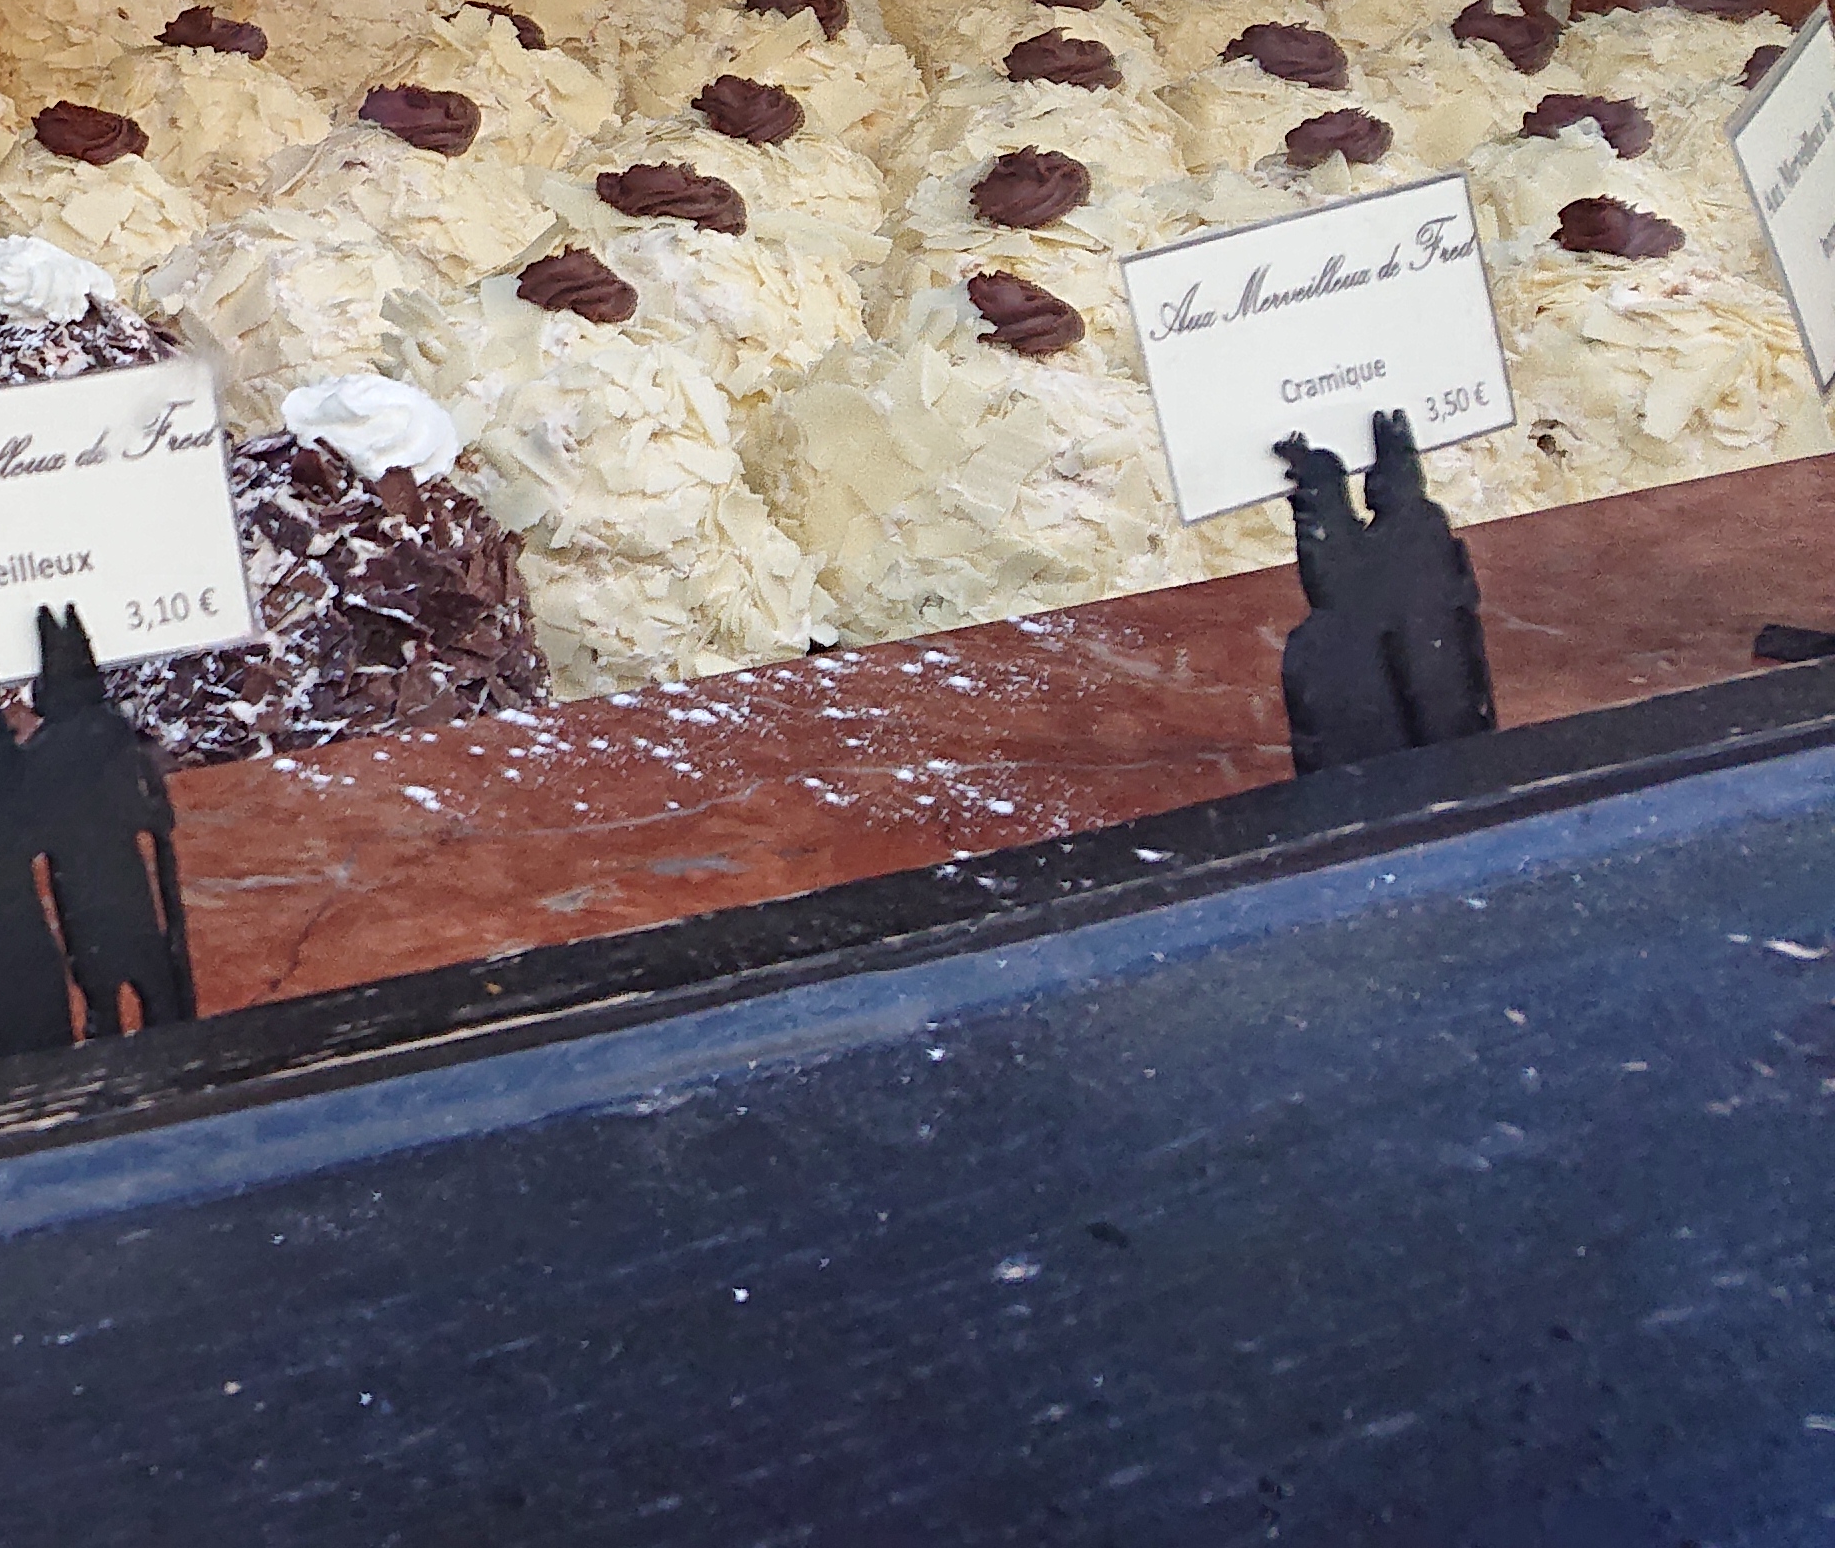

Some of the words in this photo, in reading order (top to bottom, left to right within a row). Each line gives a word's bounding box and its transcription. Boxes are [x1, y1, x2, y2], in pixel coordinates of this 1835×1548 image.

[1149, 280, 1217, 341] Aux
[1222, 253, 1373, 322] Merveilleux
[1376, 243, 1401, 282] de
[1409, 214, 1477, 272] Fred
[1280, 358, 1387, 404] Cramique
[1425, 387, 1471, 424] 3,50
[1474, 381, 1491, 408] €
[74, 428, 110, 468] de
[121, 398, 219, 461] Fred
[125, 592, 190, 633] 3,10
[198, 586, 220, 618] €
